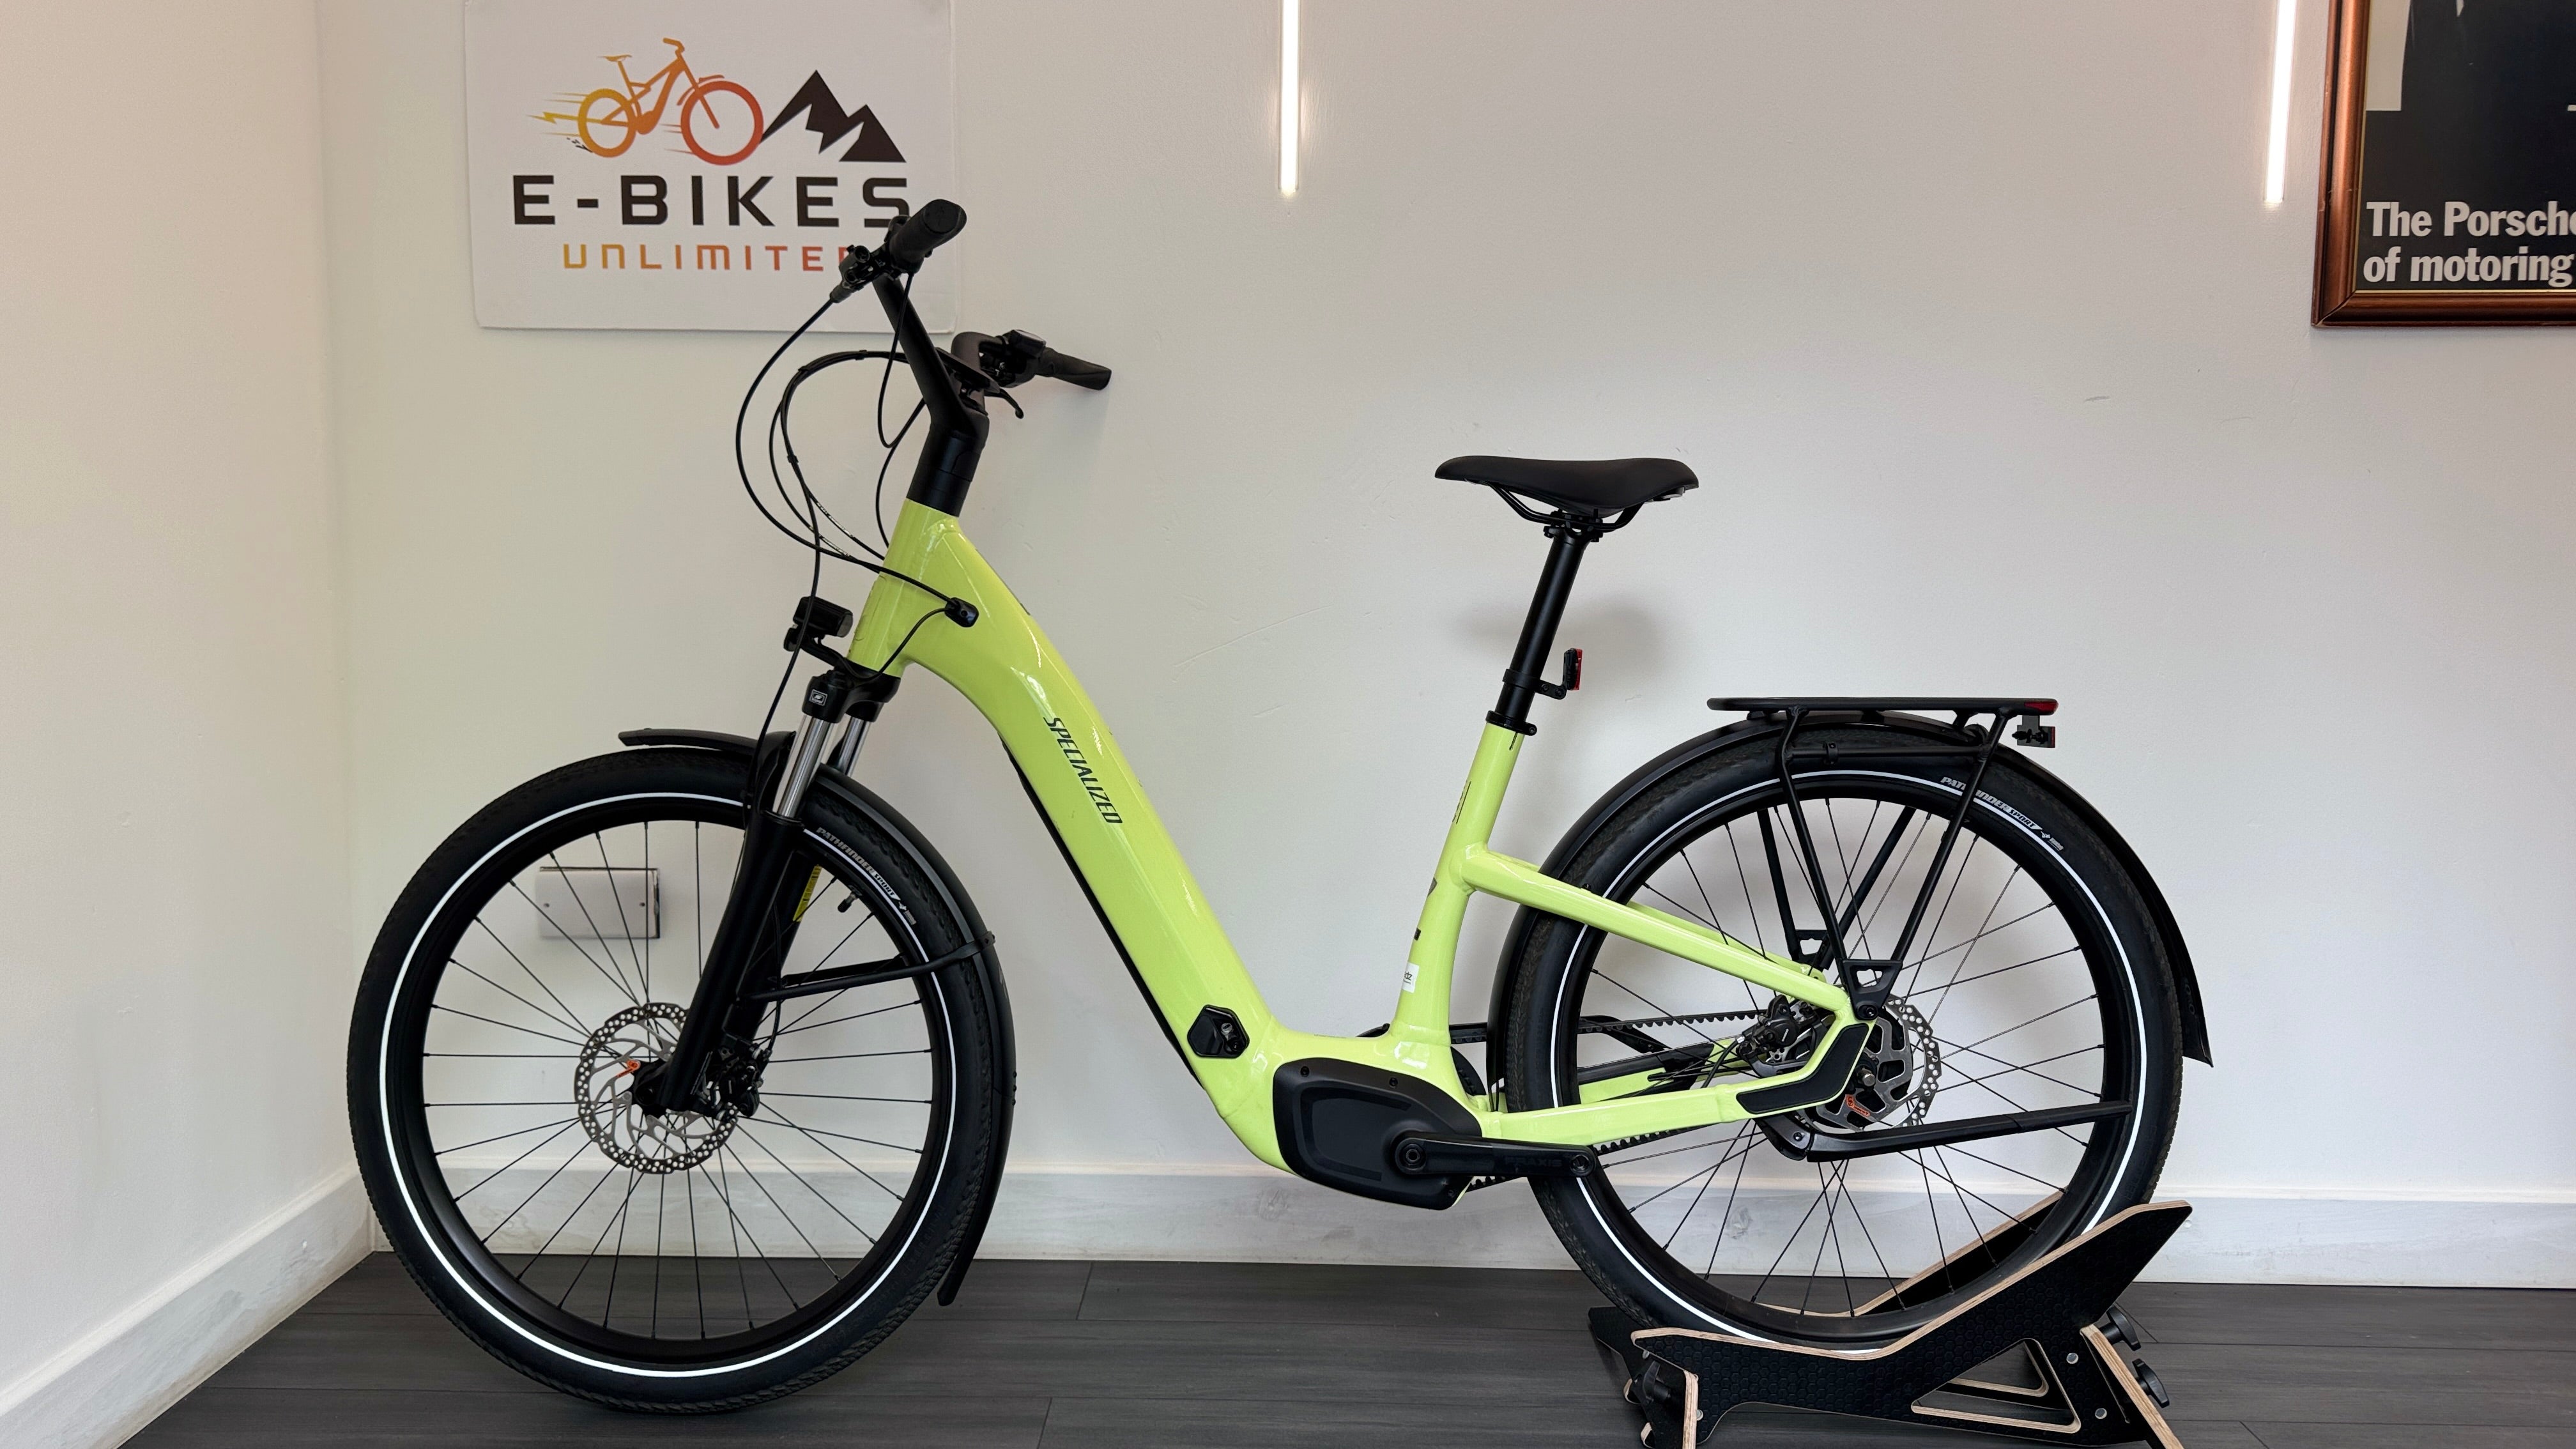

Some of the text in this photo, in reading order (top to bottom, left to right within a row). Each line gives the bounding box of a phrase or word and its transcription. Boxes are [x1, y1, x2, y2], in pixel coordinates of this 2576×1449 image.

[512, 174, 910, 228] E-BIKES
[2366, 201, 2432, 237] The
[2363, 246, 2575, 288] of motoring
[1043, 716, 1123, 824] SPECIALIZED
[2009, 809, 2036, 827] SPORT
[816, 827, 875, 874] PATHFINDER
